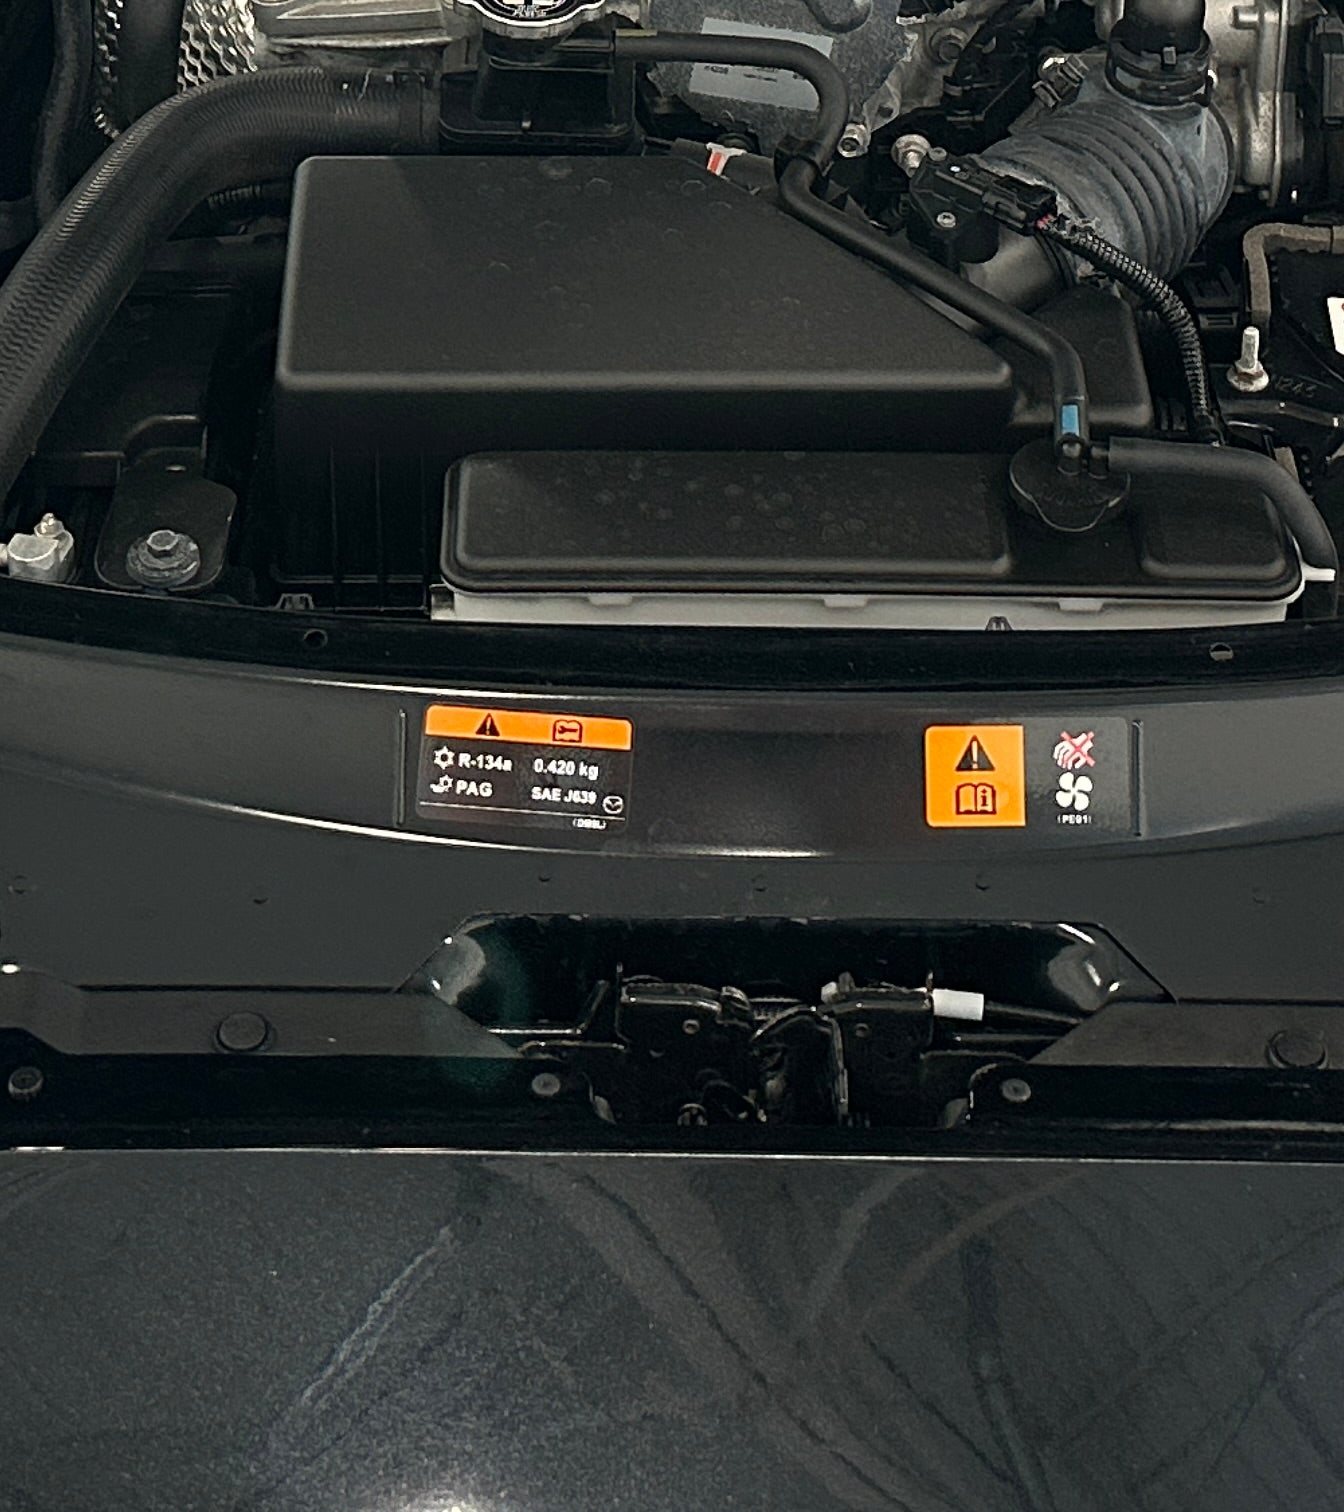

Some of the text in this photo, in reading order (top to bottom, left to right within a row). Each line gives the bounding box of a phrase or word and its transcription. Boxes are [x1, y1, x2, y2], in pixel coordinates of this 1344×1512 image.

[458, 752, 599, 780] R-134a 0.420 kg
[456, 779, 493, 797] PAG
[531, 786, 561, 802] SAE
